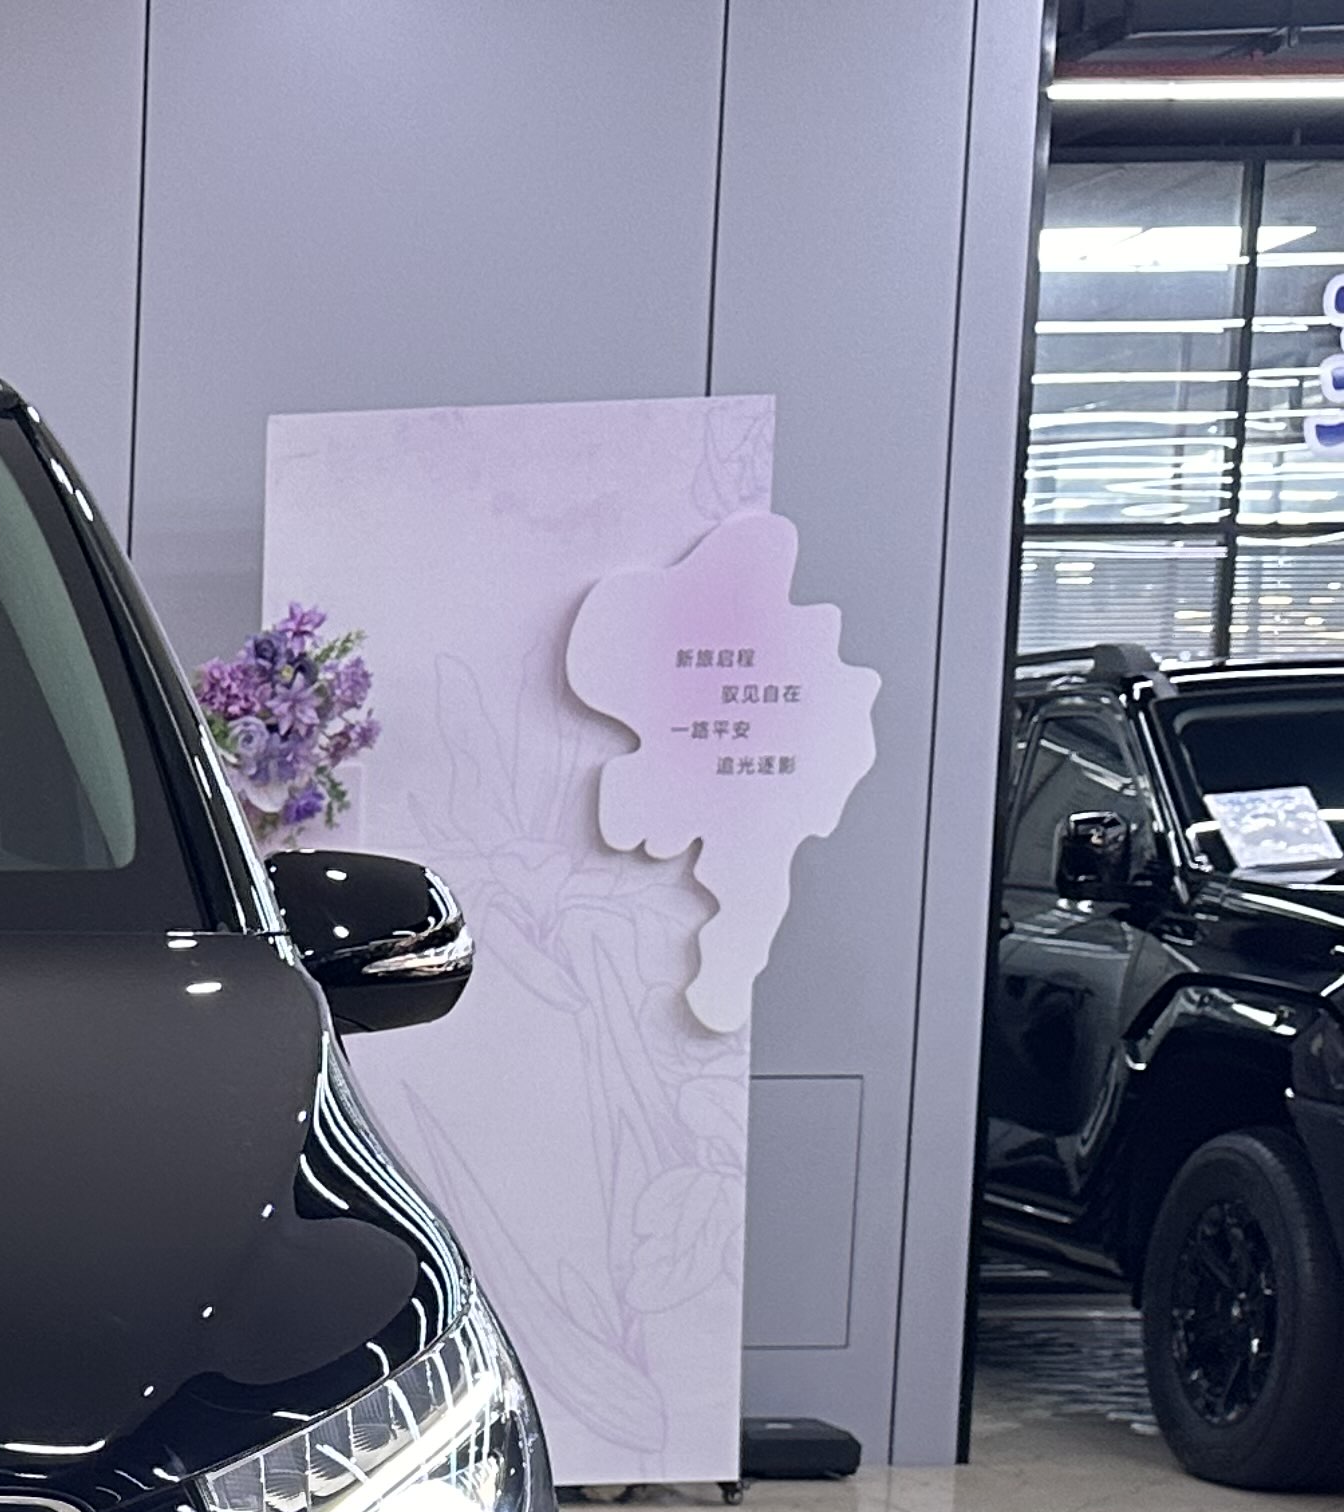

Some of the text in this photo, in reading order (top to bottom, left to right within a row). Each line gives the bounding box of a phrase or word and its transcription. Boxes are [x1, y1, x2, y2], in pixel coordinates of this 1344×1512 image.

[675, 648, 756, 668] 新旅启程
[670, 720, 751, 739] 一路平安
[716, 755, 796, 775] 追光逐影
